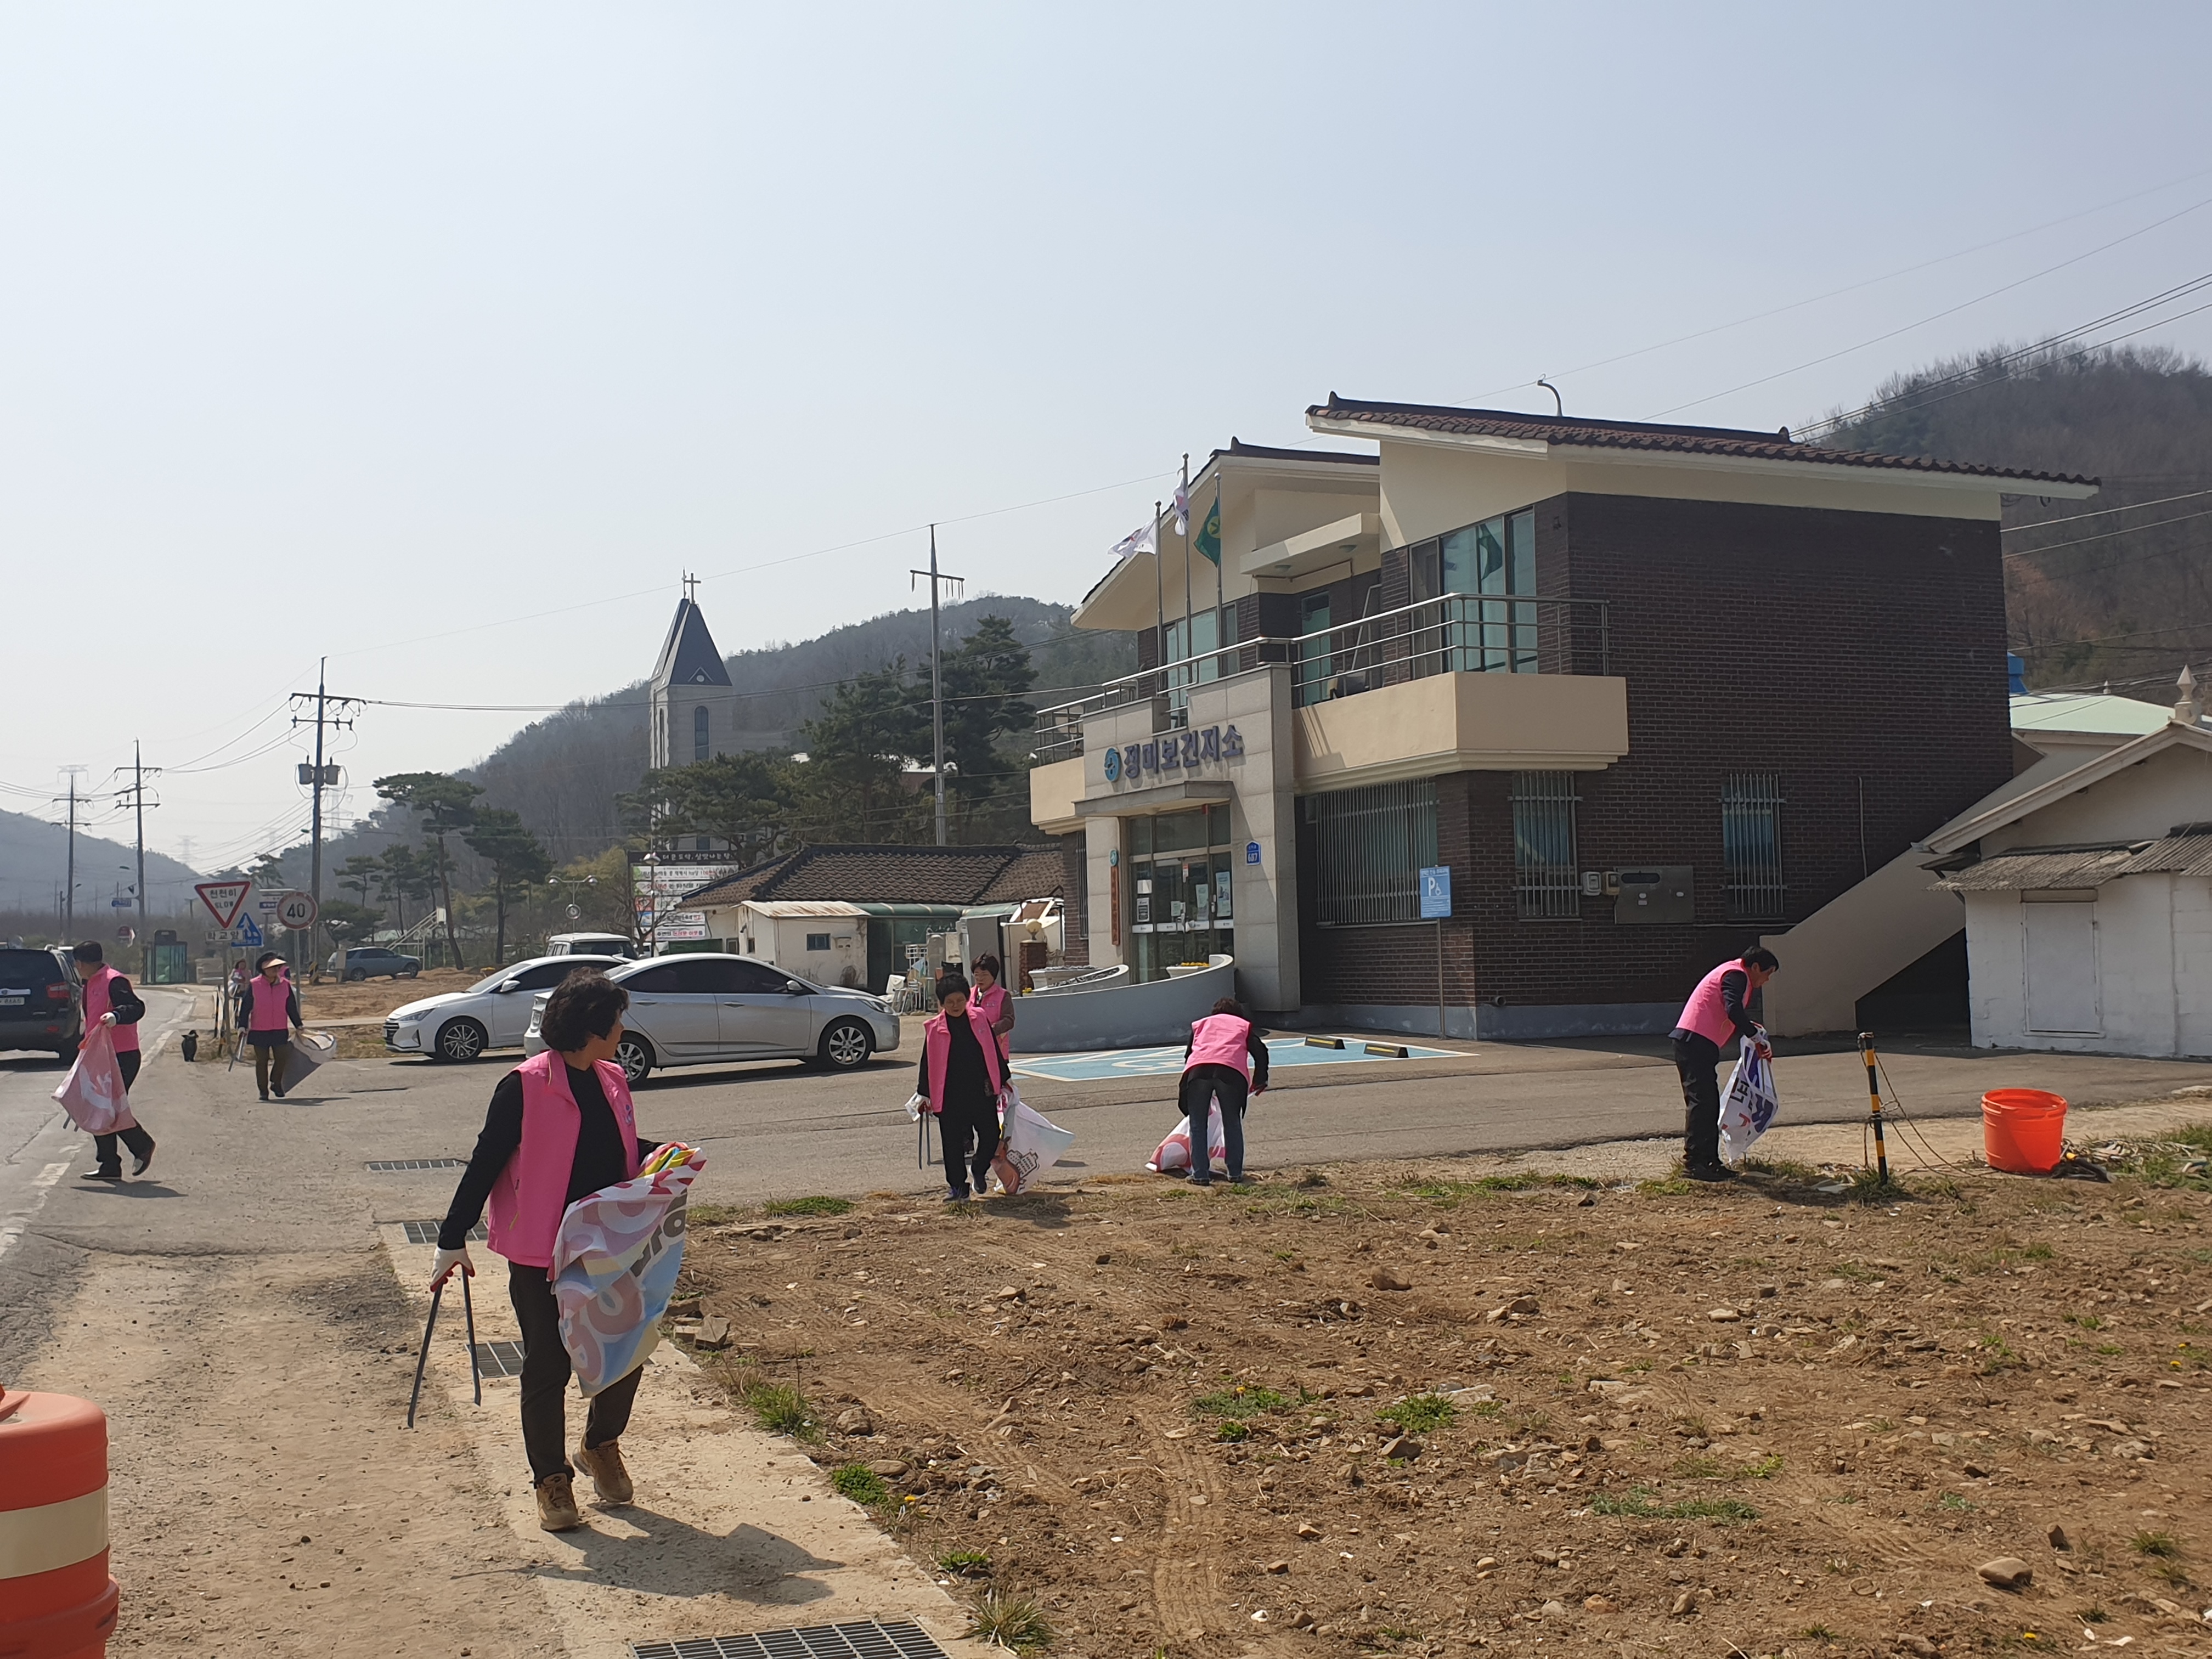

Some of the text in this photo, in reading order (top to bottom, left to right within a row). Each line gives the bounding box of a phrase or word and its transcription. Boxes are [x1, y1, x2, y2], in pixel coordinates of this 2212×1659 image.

[1124, 724, 1244, 778] 정미보건지소
[210, 888, 236, 899] 천천히
[286, 903, 306, 918] 40
[207, 931, 239, 940] 학교앞
